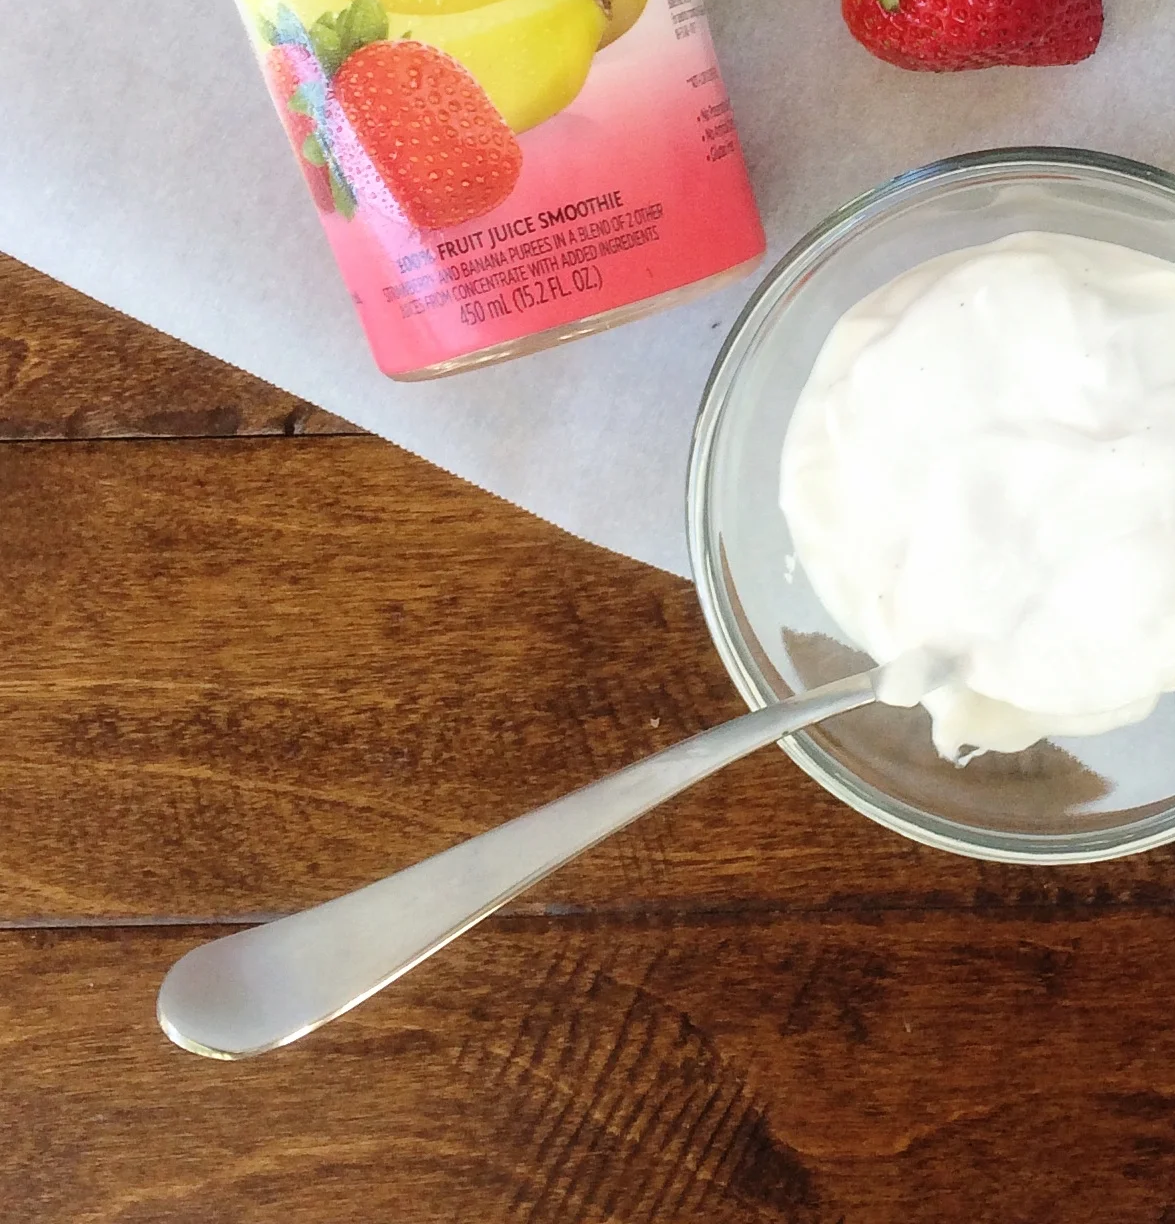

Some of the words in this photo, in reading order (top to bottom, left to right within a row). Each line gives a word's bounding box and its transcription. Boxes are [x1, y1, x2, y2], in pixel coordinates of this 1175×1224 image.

[436, 231, 483, 261] FRUIT
[488, 216, 536, 249] JUICE
[537, 190, 624, 229] SMOOTHIE
[438, 265, 461, 284] AND
[461, 250, 508, 278] BANANA
[508, 236, 552, 263] PUREES
[553, 231, 567, 250] IN
[568, 229, 578, 244] A
[577, 219, 611, 242] BLEND
[610, 215, 625, 231] OF
[624, 212, 634, 227] 2
[634, 203, 664, 225] OTHER
[424, 289, 452, 309] FROM
[451, 265, 529, 301] CONCENTRATE
[526, 257, 559, 278] WITH
[561, 244, 598, 268] ADDED
[599, 225, 660, 256] INGREDIENTS
[460, 300, 486, 326] 450
[487, 293, 512, 319] mL
[512, 281, 549, 314] (15.2
[547, 275, 572, 300] FL.
[572, 265, 604, 291] OZ.)
